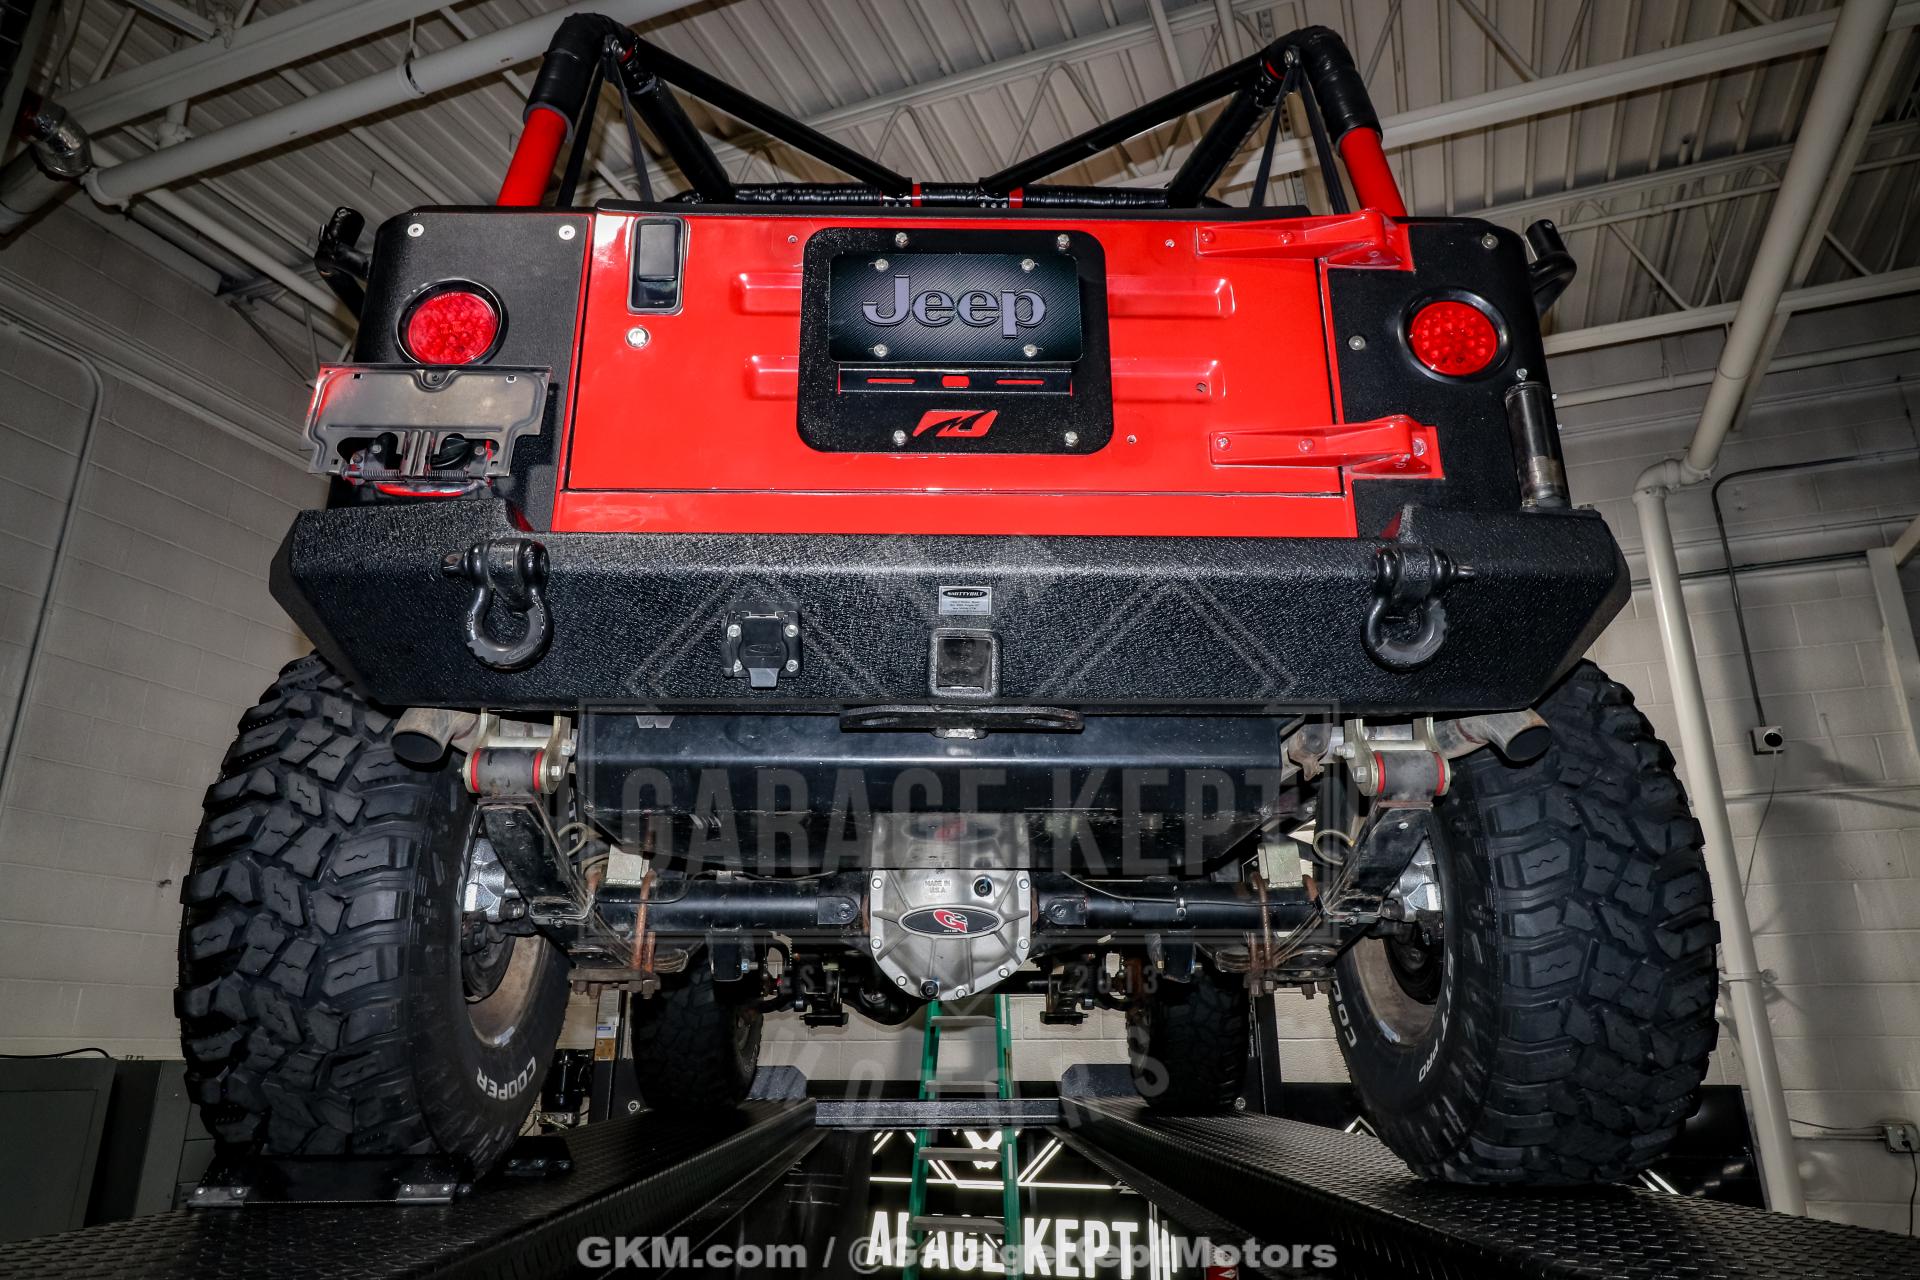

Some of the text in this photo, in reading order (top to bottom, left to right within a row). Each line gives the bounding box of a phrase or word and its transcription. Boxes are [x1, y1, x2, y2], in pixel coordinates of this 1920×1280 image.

[862, 275, 1047, 338] Jeep
[1332, 980, 1357, 1048] COO
[476, 1056, 536, 1100] COOPER
[1419, 1038, 1438, 1083] PRO
[1024, 1217, 1138, 1280] KEPT
